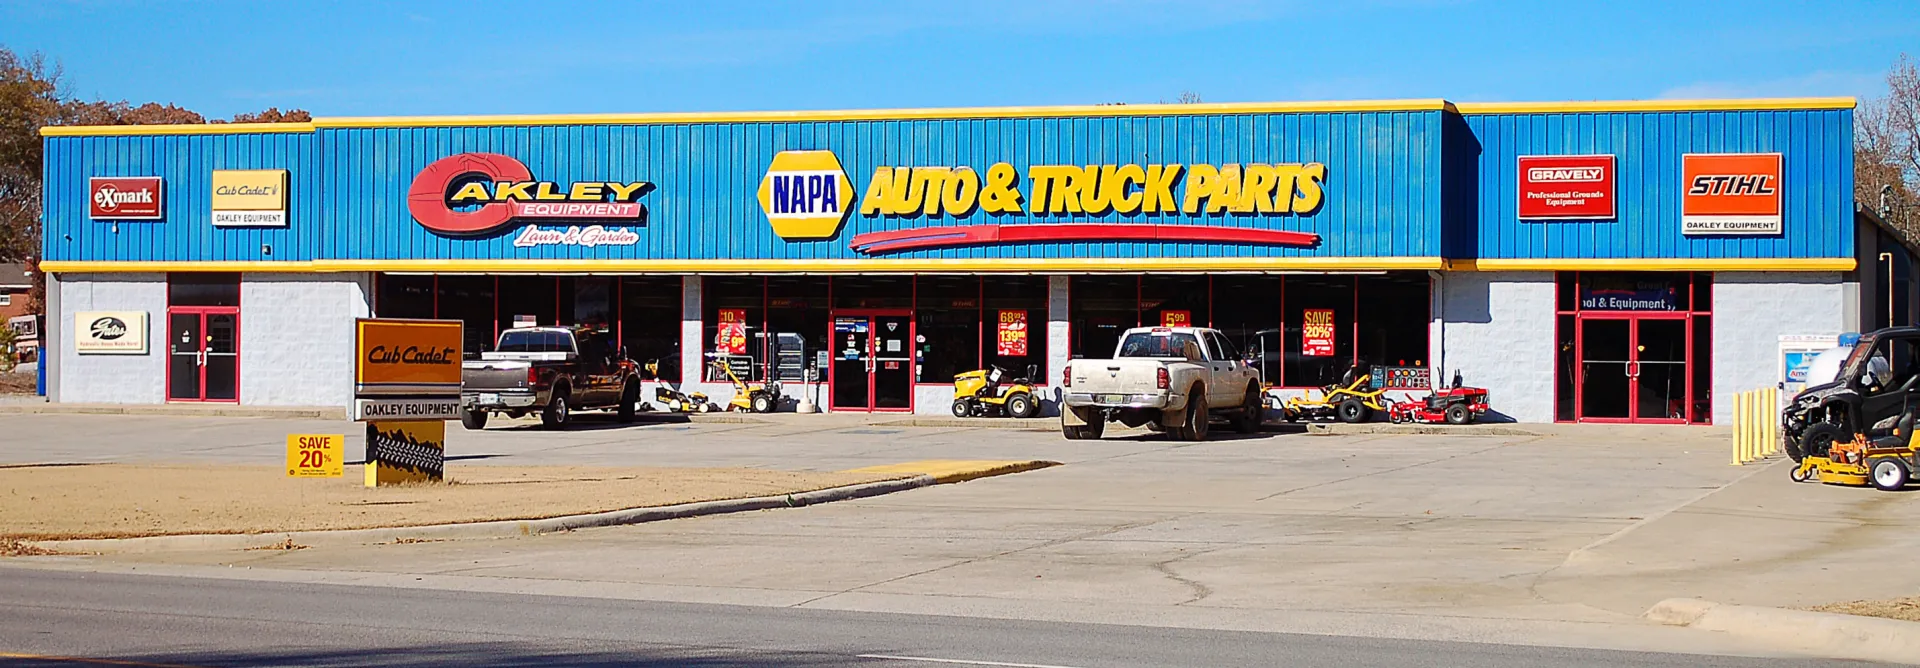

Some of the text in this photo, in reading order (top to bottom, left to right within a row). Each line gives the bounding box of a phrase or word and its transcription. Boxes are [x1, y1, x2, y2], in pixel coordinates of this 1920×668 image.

[1530, 168, 1601, 181] GRAVELY
[216, 185, 270, 196] Cub Cadet
[862, 161, 1327, 216] AUTO & TRUCK PARTS
[1688, 174, 1775, 197] STIHL
[772, 176, 838, 214] NAPA
[1527, 191, 1604, 199] Professional Grounds
[1545, 198, 1585, 207] Equipment
[523, 203, 633, 216] EQUIPMENT
[216, 214, 282, 223] OAKLEY EQUIPMENT
[1686, 221, 1775, 229] OAKLEY EQUIPMENT
[516, 225, 639, 245] Lawn & Garden
[1598, 297, 1607, 308] &
[1609, 297, 1666, 310] Equipment
[1305, 311, 1332, 325] SAVE
[1305, 326, 1331, 338] 20%
[368, 345, 455, 364] Cub Cadet
[365, 402, 459, 416] OAKLEY EQUIPMENT
[298, 436, 331, 449] SAVE
[299, 450, 332, 468] 20%
